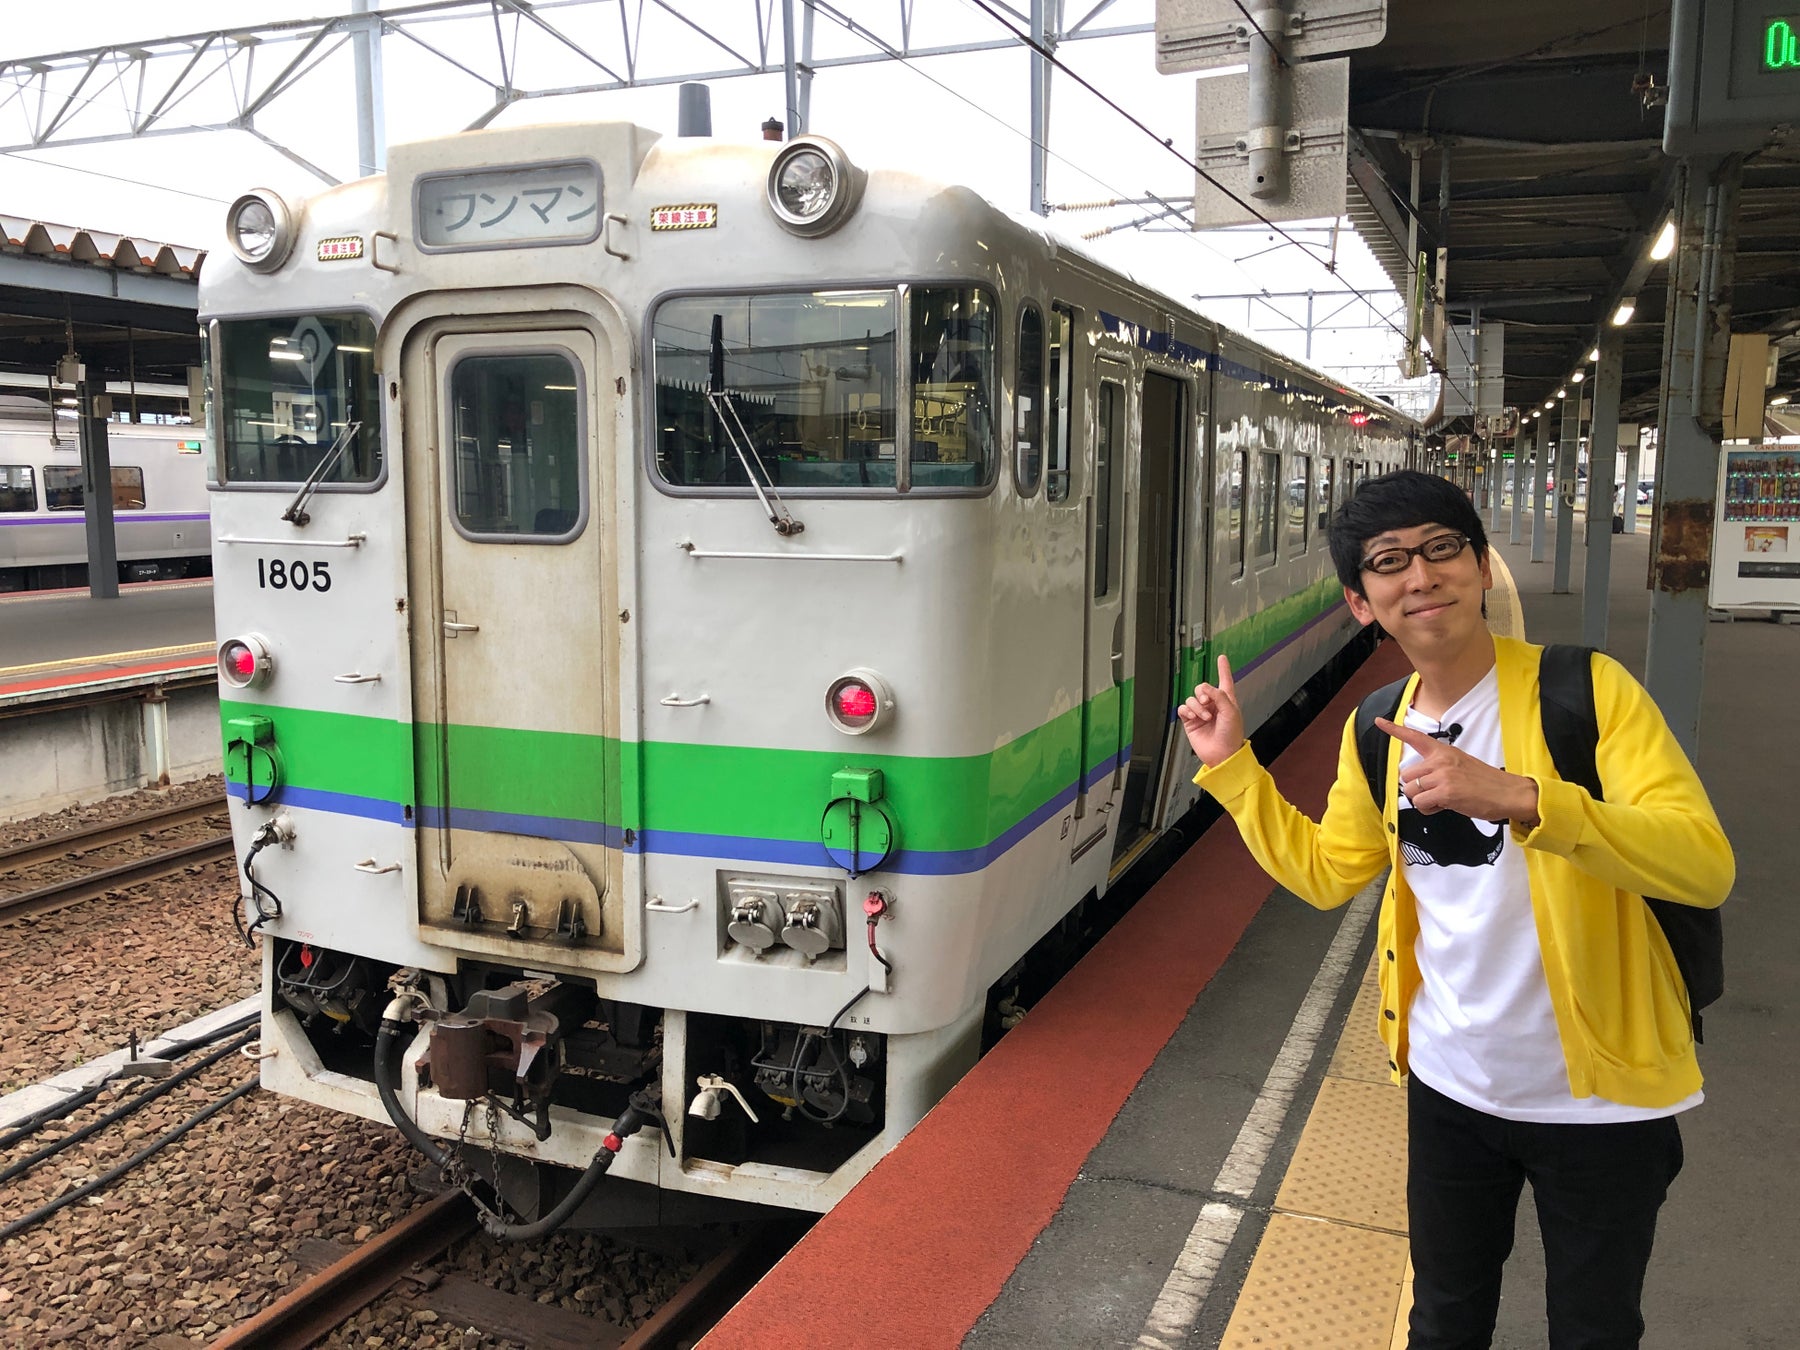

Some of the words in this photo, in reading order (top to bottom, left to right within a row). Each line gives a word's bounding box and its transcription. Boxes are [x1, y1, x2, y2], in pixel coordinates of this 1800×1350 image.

[658, 211, 707, 224] 架線注意
[258, 558, 331, 592] 1805
